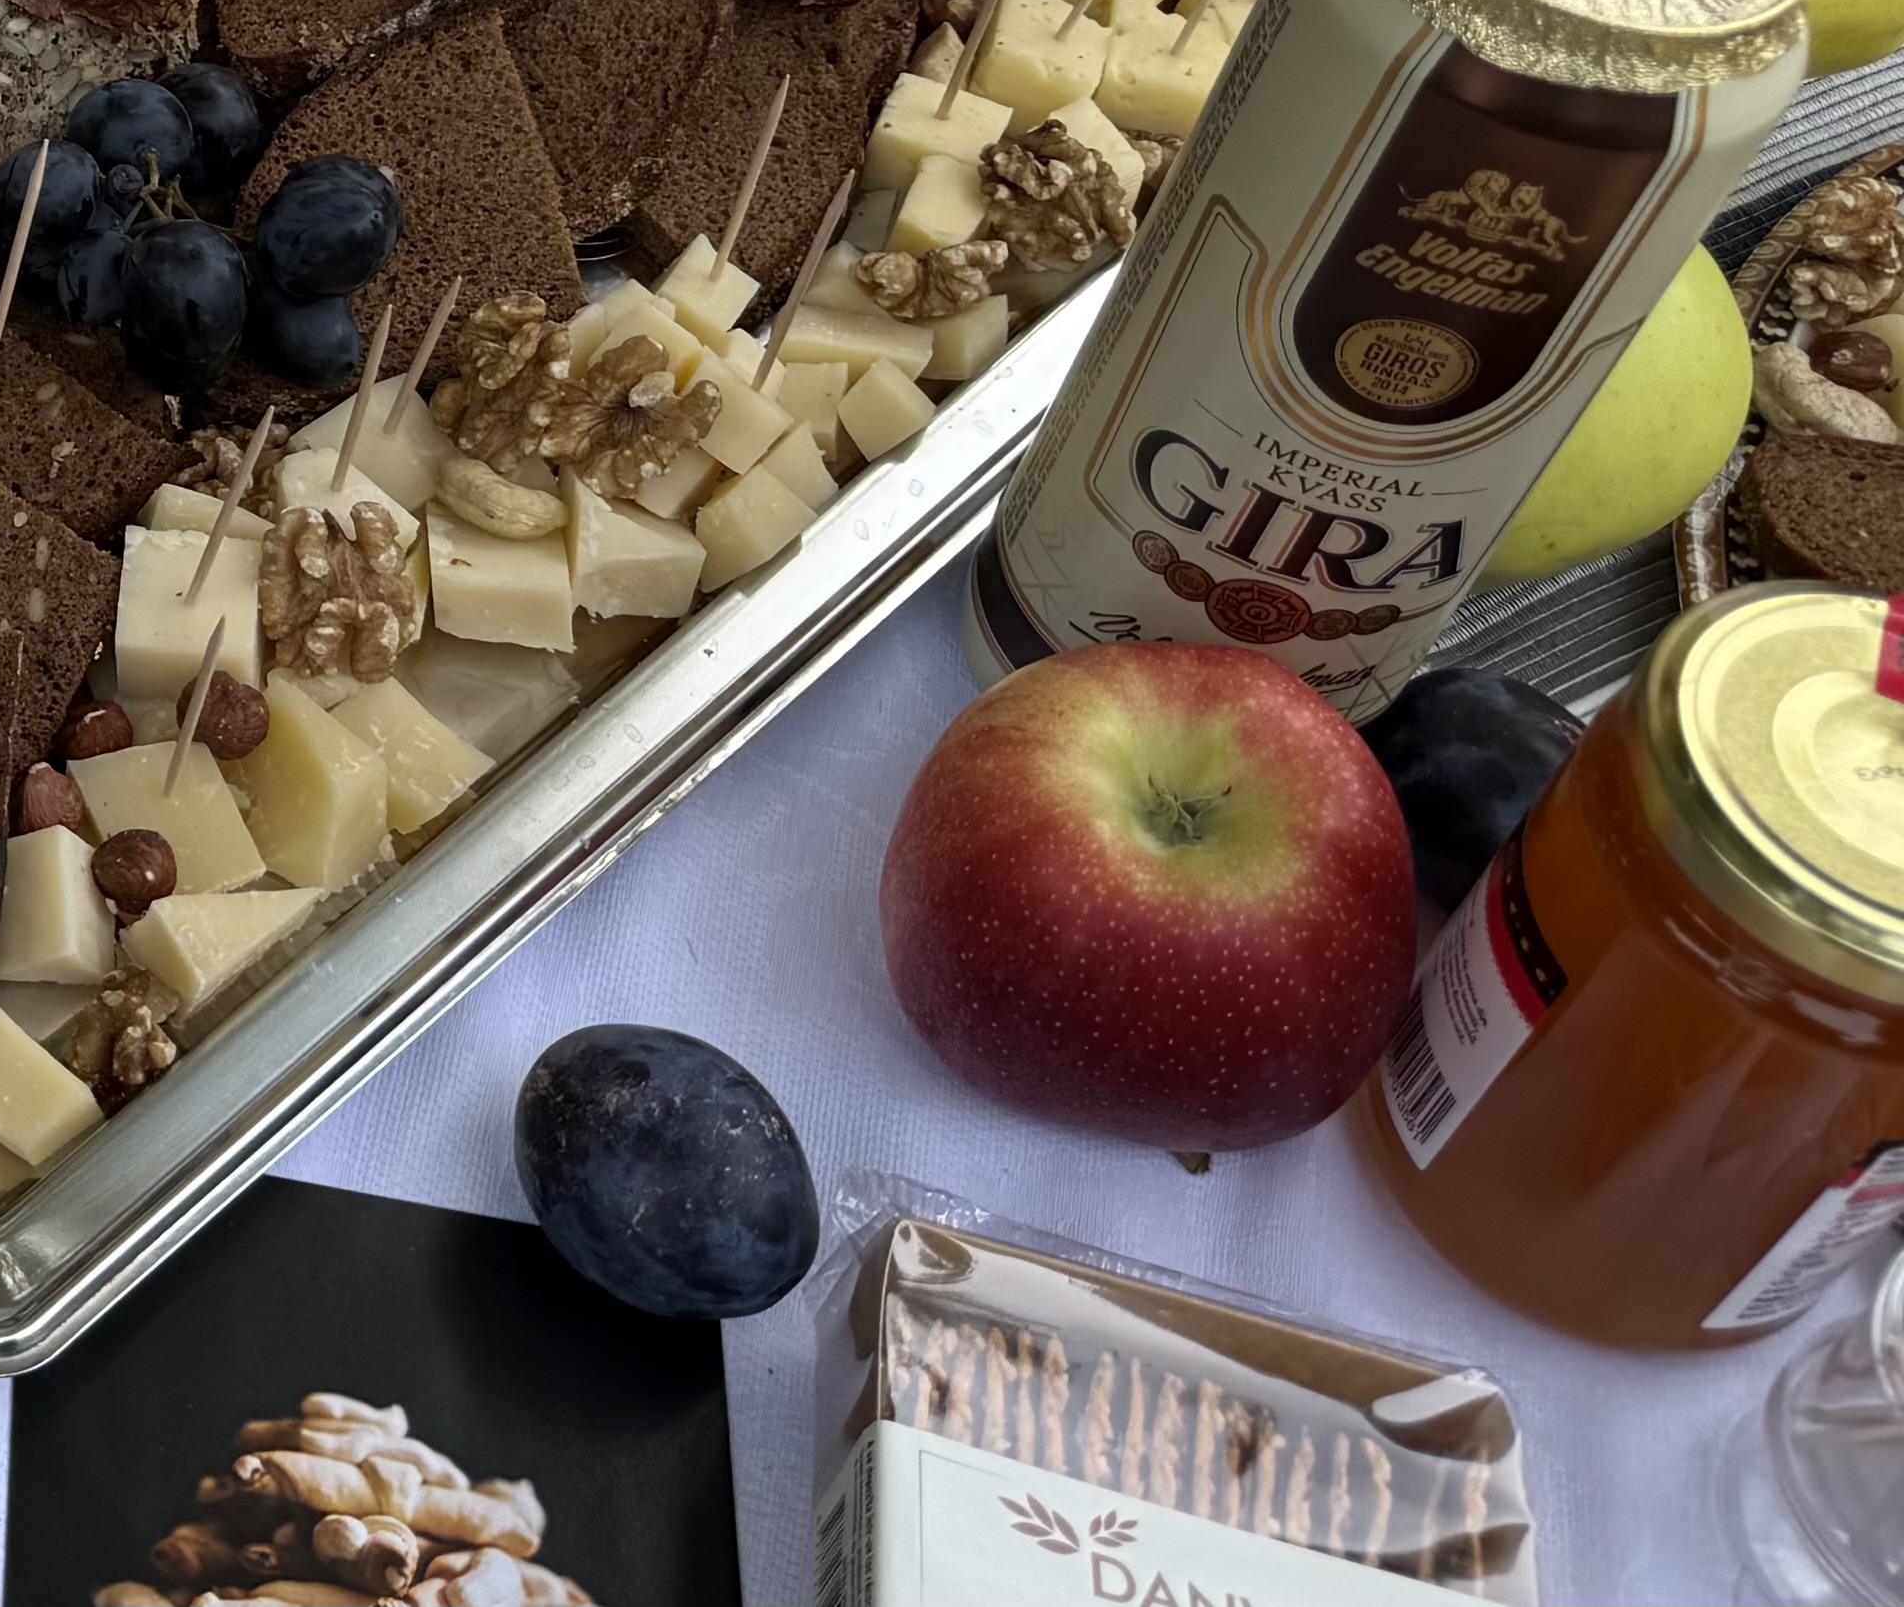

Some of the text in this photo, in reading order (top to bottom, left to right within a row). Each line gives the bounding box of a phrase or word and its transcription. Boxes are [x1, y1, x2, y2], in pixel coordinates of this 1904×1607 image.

[1355, 244, 1549, 319] Engelman
[1408, 231, 1531, 286] Volfas
[1359, 360, 1433, 390] RINGAS
[1365, 342, 1447, 382] GIROS
[1252, 431, 1427, 499] IMPERIAL
[1266, 467, 1389, 516] KVASS
[1131, 427, 1468, 596] GIRA
